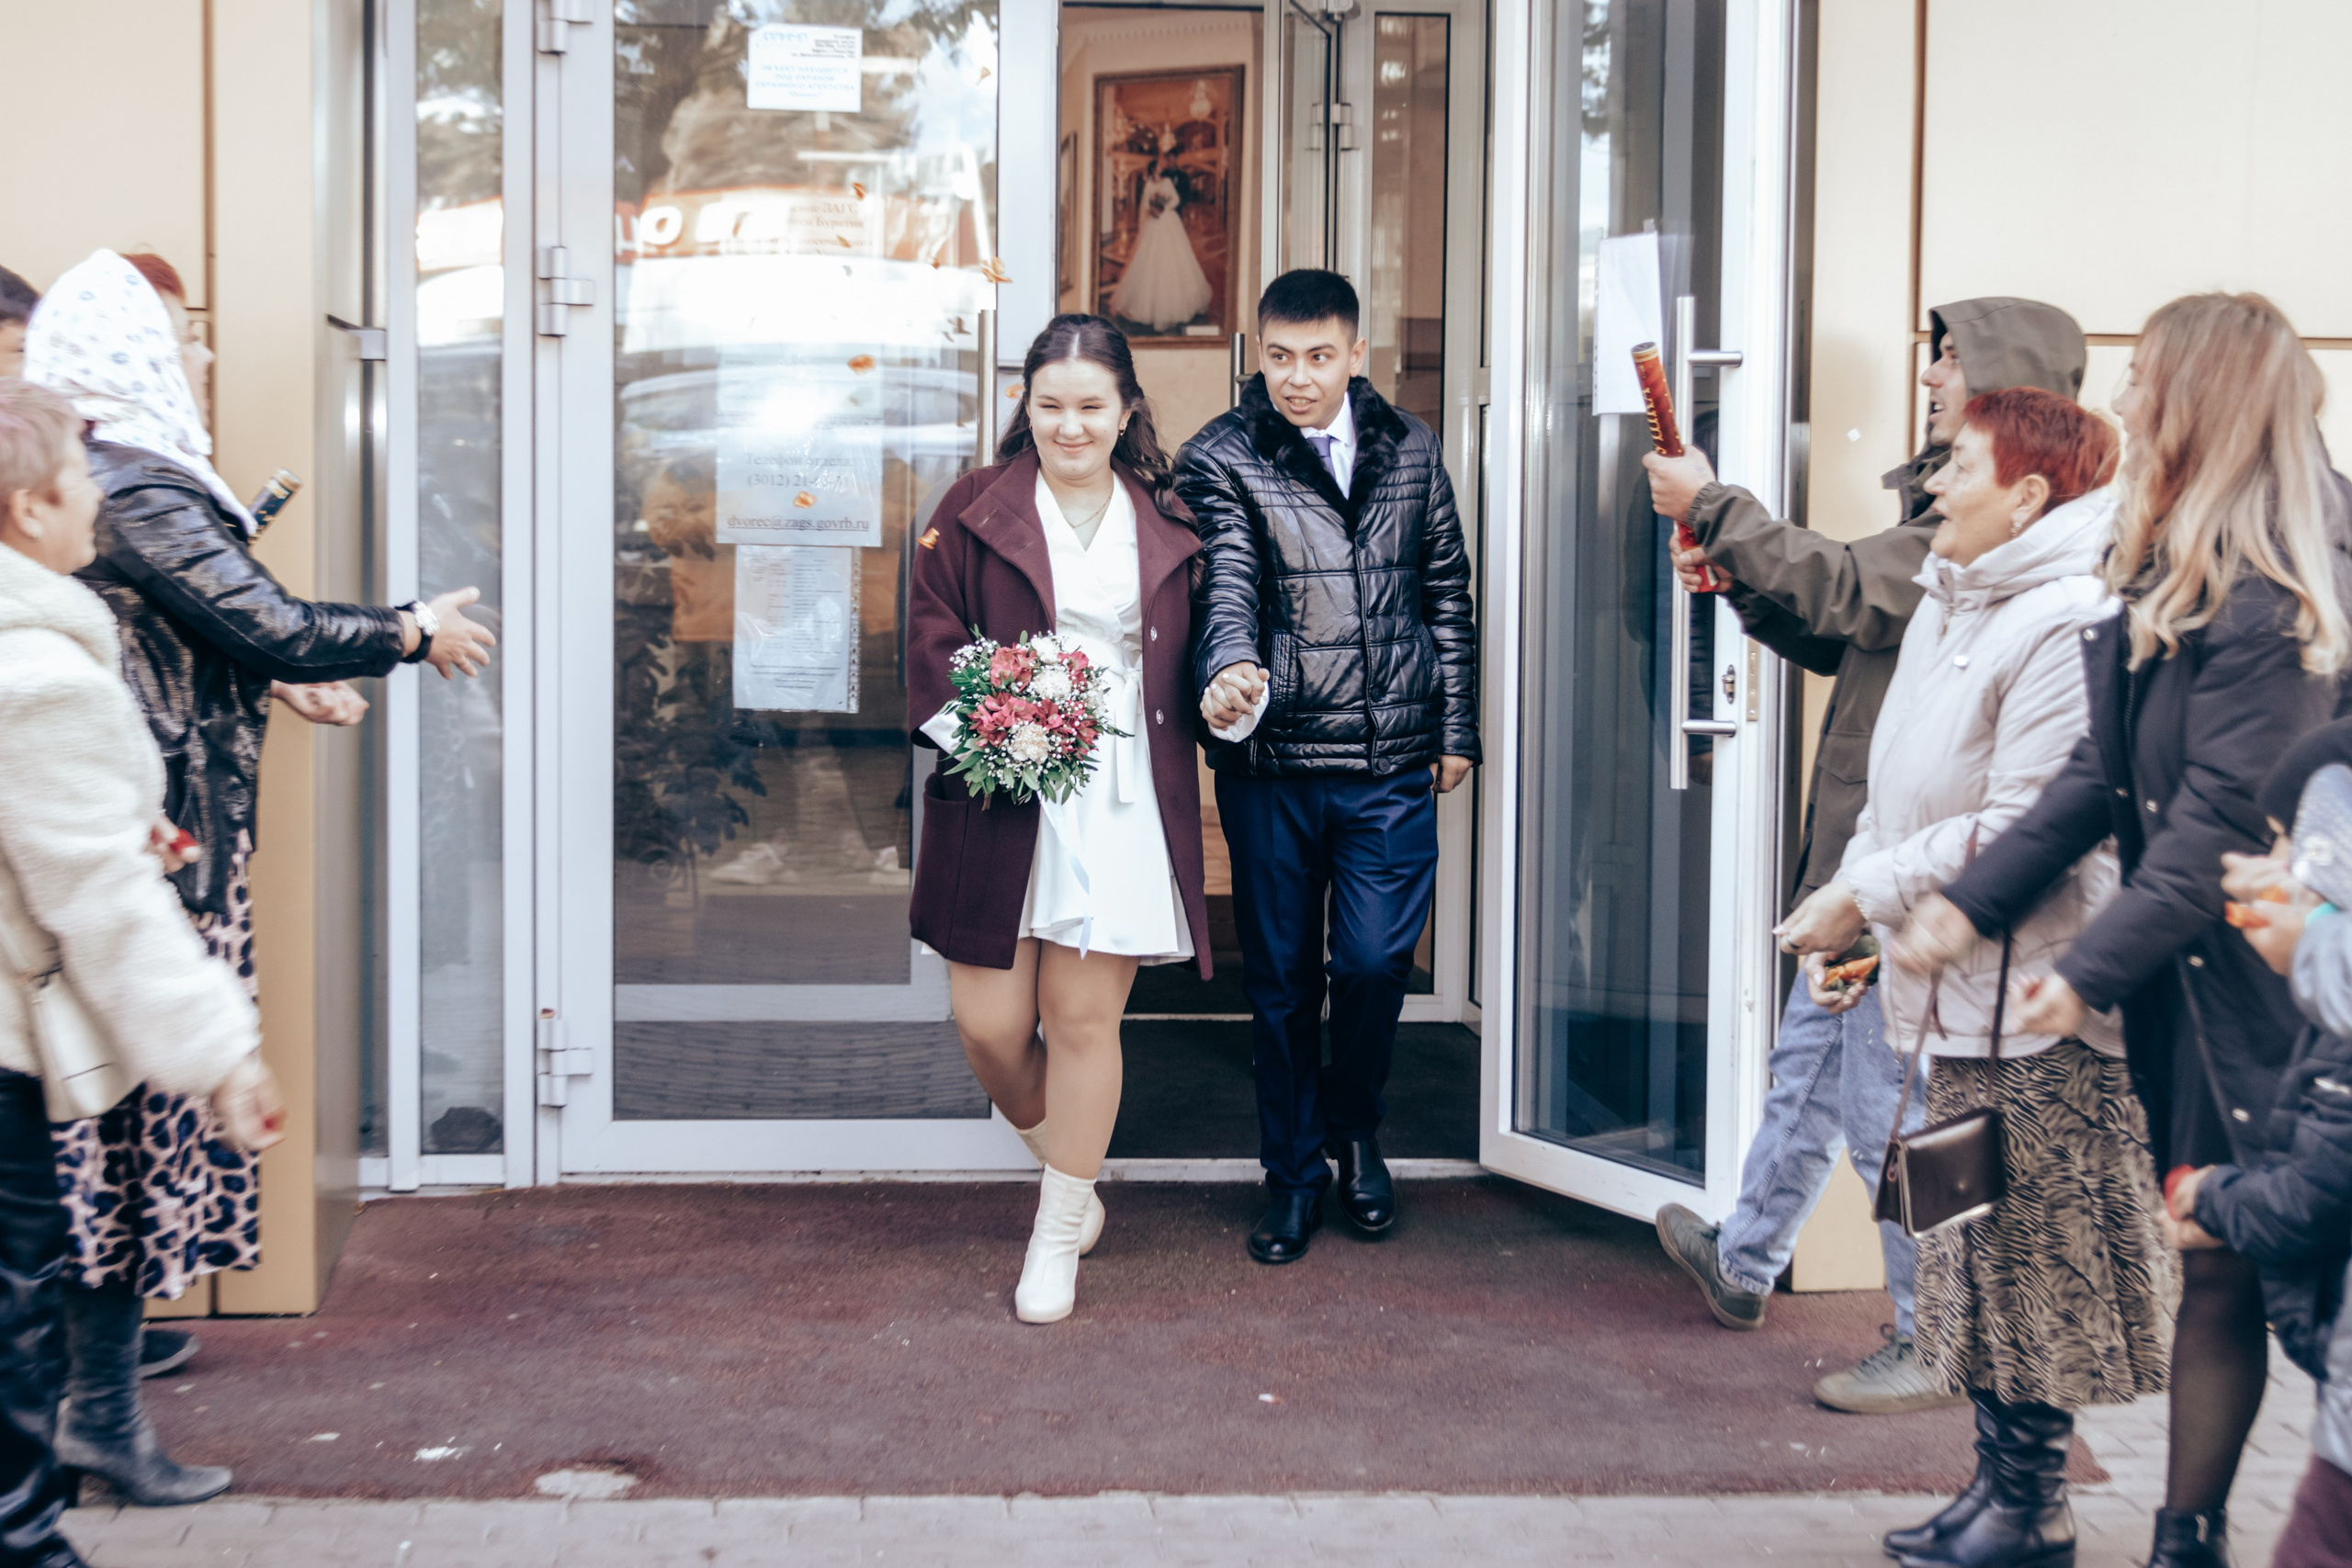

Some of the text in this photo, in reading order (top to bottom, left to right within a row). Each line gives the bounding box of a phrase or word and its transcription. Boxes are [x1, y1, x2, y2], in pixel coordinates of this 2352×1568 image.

[743, 453, 802, 468] Телефон
[747, 474, 790, 489] (3012)
[728, 514, 869, 531] dvorec@zags.govrb.ru
